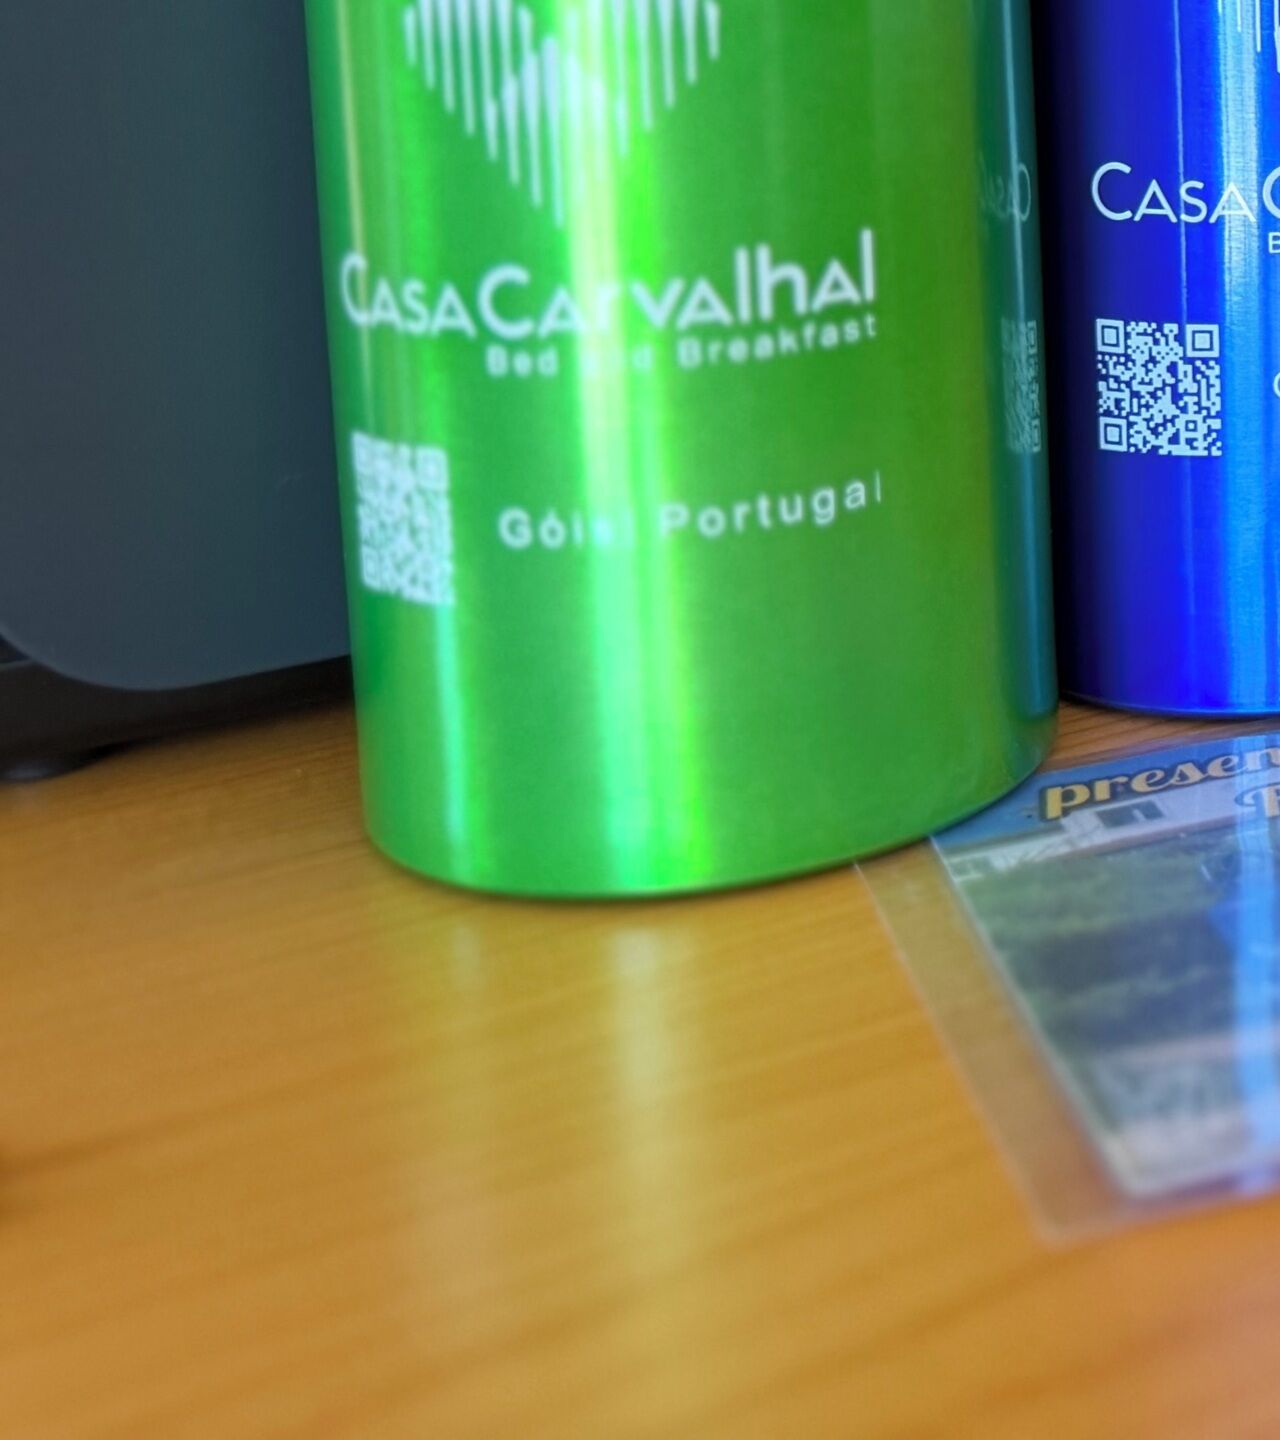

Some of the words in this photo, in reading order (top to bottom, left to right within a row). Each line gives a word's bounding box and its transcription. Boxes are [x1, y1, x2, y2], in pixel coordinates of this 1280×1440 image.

[485, 344, 559, 378] Bed
[676, 311, 878, 370] Breakfast
[657, 469, 883, 539] Portugal
